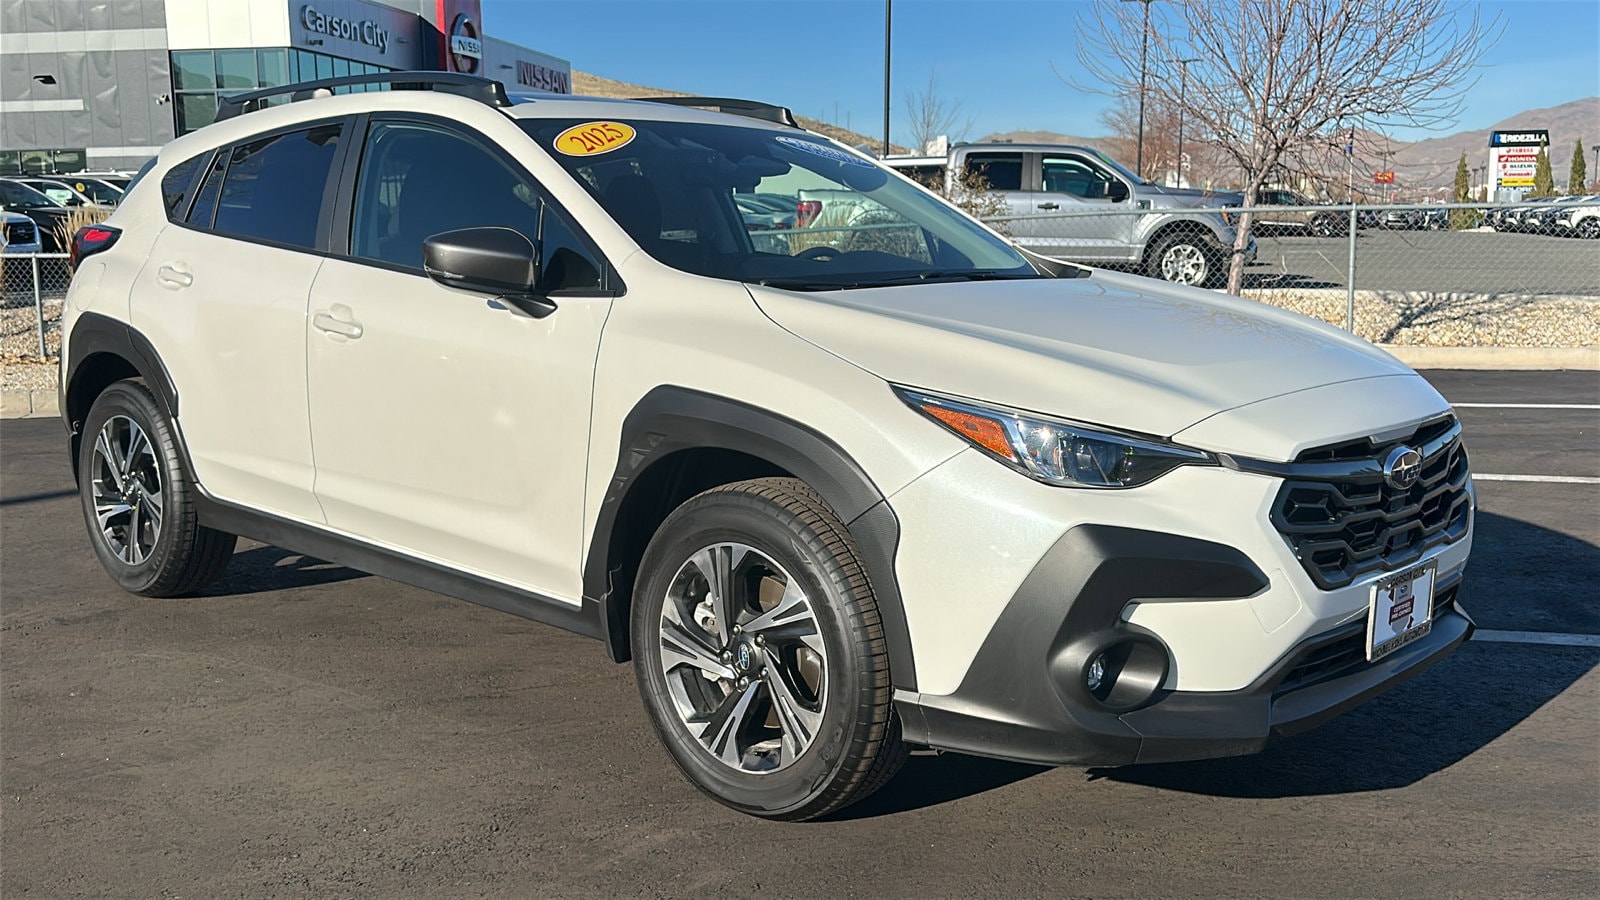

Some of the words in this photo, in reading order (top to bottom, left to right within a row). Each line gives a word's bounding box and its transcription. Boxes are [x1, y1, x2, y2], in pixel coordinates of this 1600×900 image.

[302, 5, 360, 41] Carson
[361, 20, 389, 54] City
[517, 60, 568, 94] NISSAN
[569, 123, 624, 152] 2025
[1507, 134, 1547, 142] RIDEZILLA
